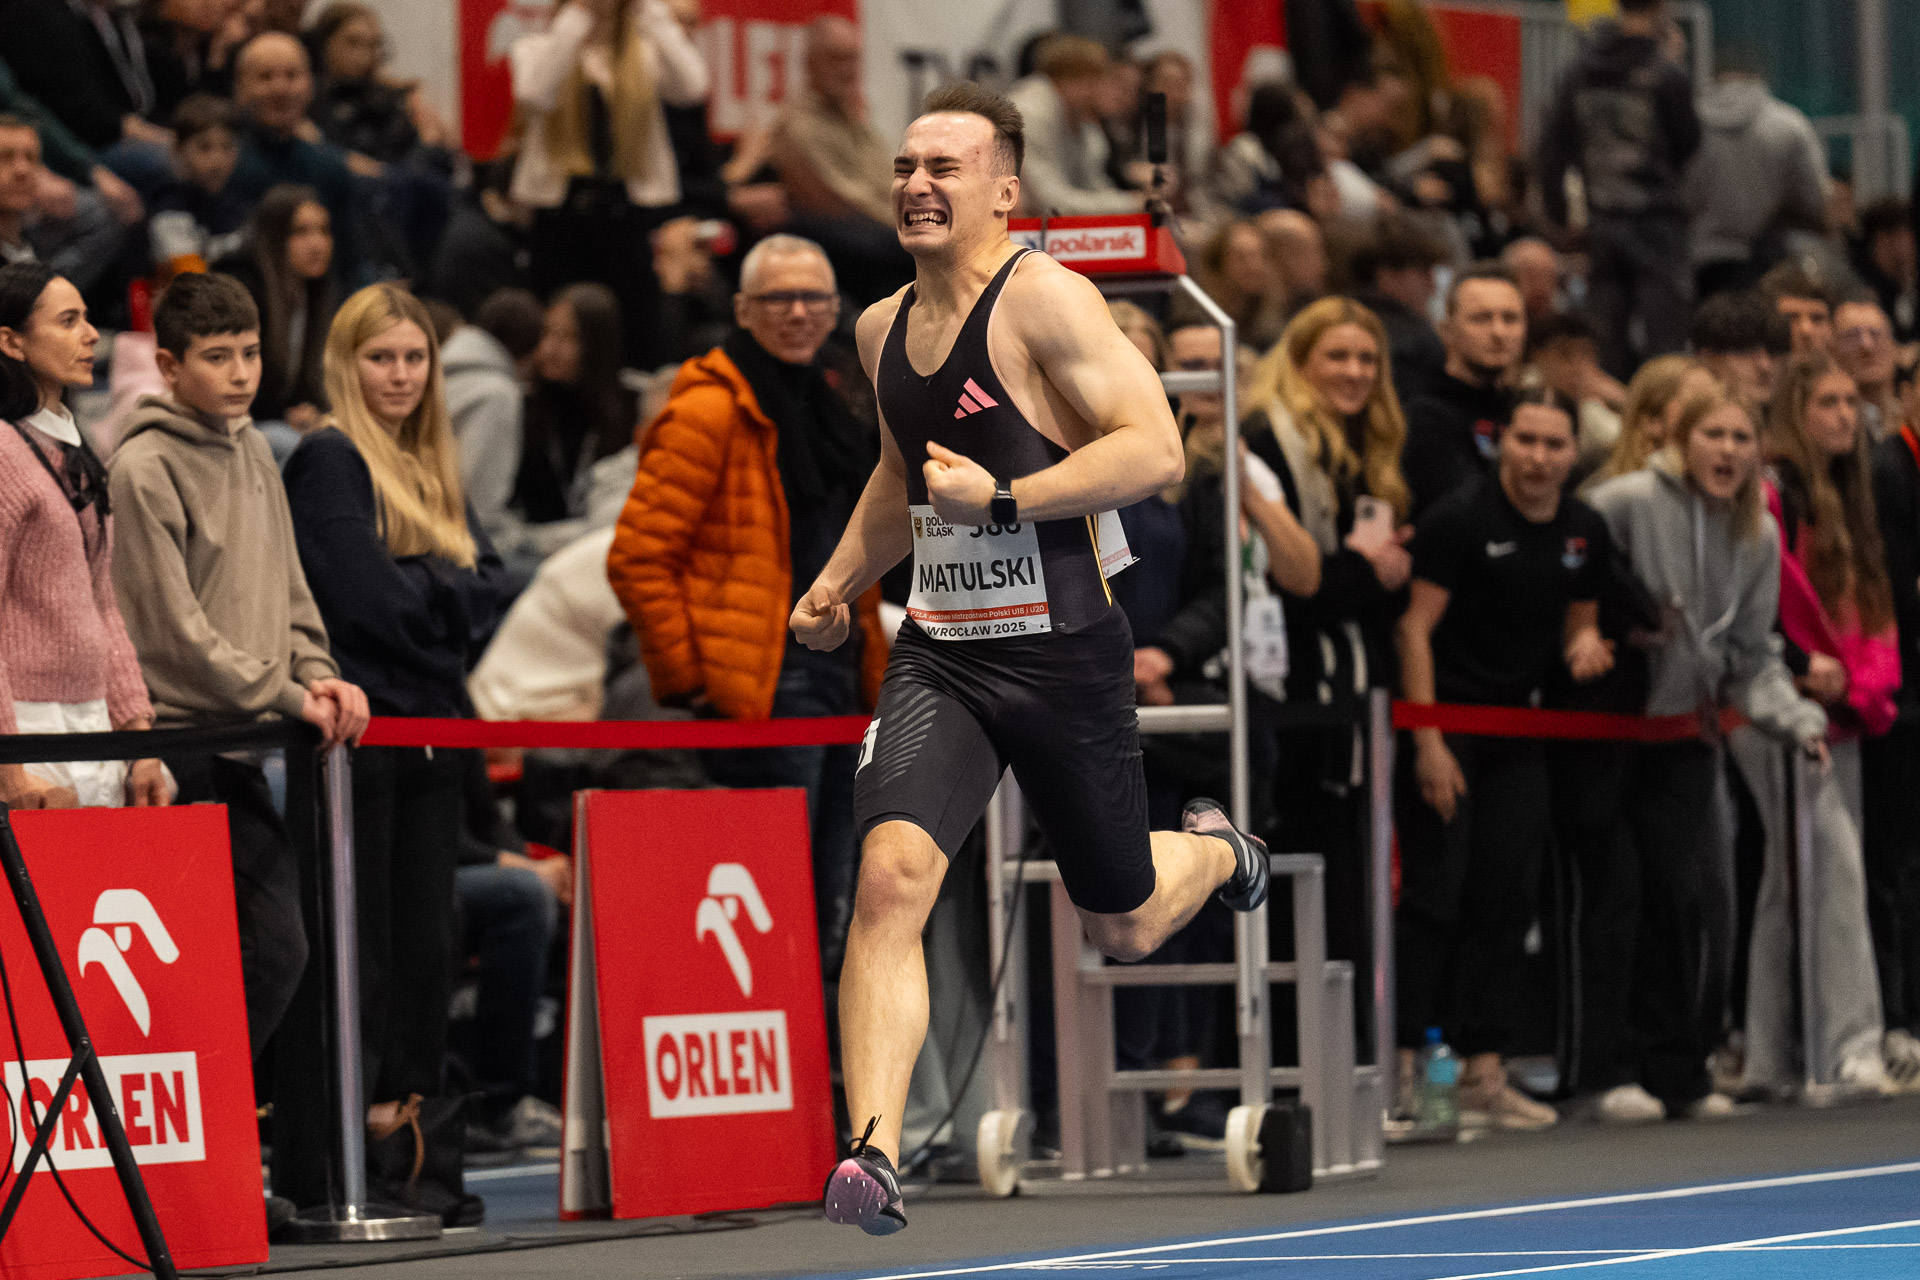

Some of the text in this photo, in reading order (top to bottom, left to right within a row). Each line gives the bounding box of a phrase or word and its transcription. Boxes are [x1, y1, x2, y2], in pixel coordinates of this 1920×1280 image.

[926, 516, 954, 526] DOL
[926, 525, 955, 538] ŚLĄSK
[919, 556, 1036, 593] MATULSKI
[989, 608, 1010, 618] Polski
[1012, 607, 1025, 615] U18
[1030, 604, 1045, 613] U20
[927, 621, 1027, 637] WROCŁAW 2025
[656, 1028, 780, 1101] ORLEN
